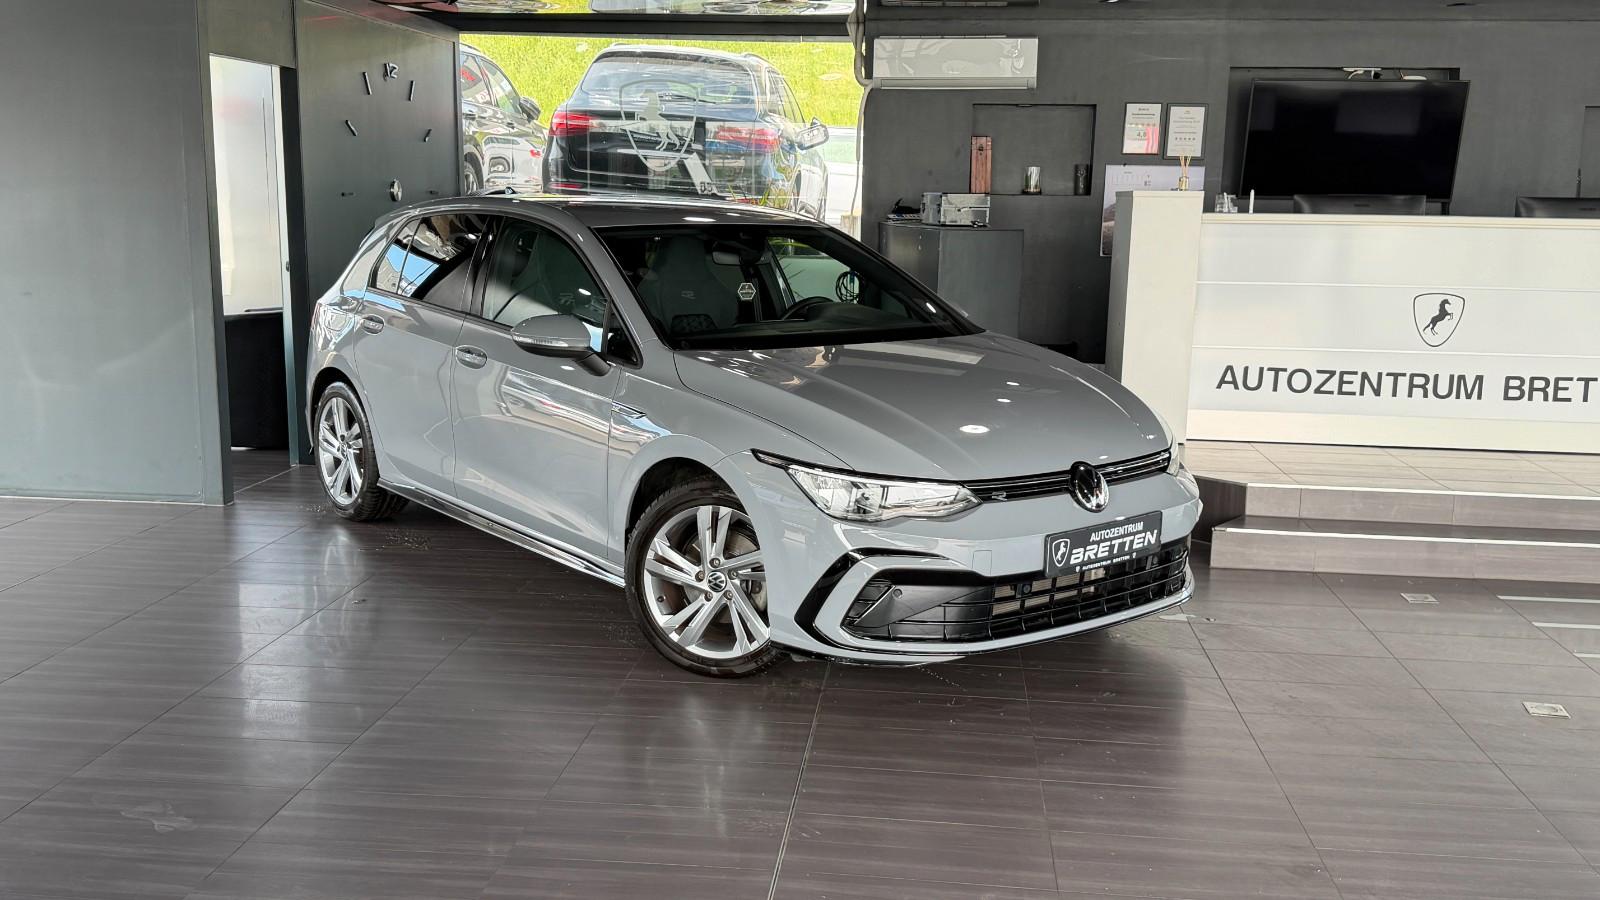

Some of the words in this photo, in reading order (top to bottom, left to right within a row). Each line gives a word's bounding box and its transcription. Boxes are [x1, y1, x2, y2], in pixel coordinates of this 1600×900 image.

[1215, 364, 1484, 401] AUTOZENTRUM
[1502, 375, 1599, 403] BRET
[1069, 529, 1158, 565] BRETTEN
[1089, 521, 1144, 543] AUTOZENTRUM
